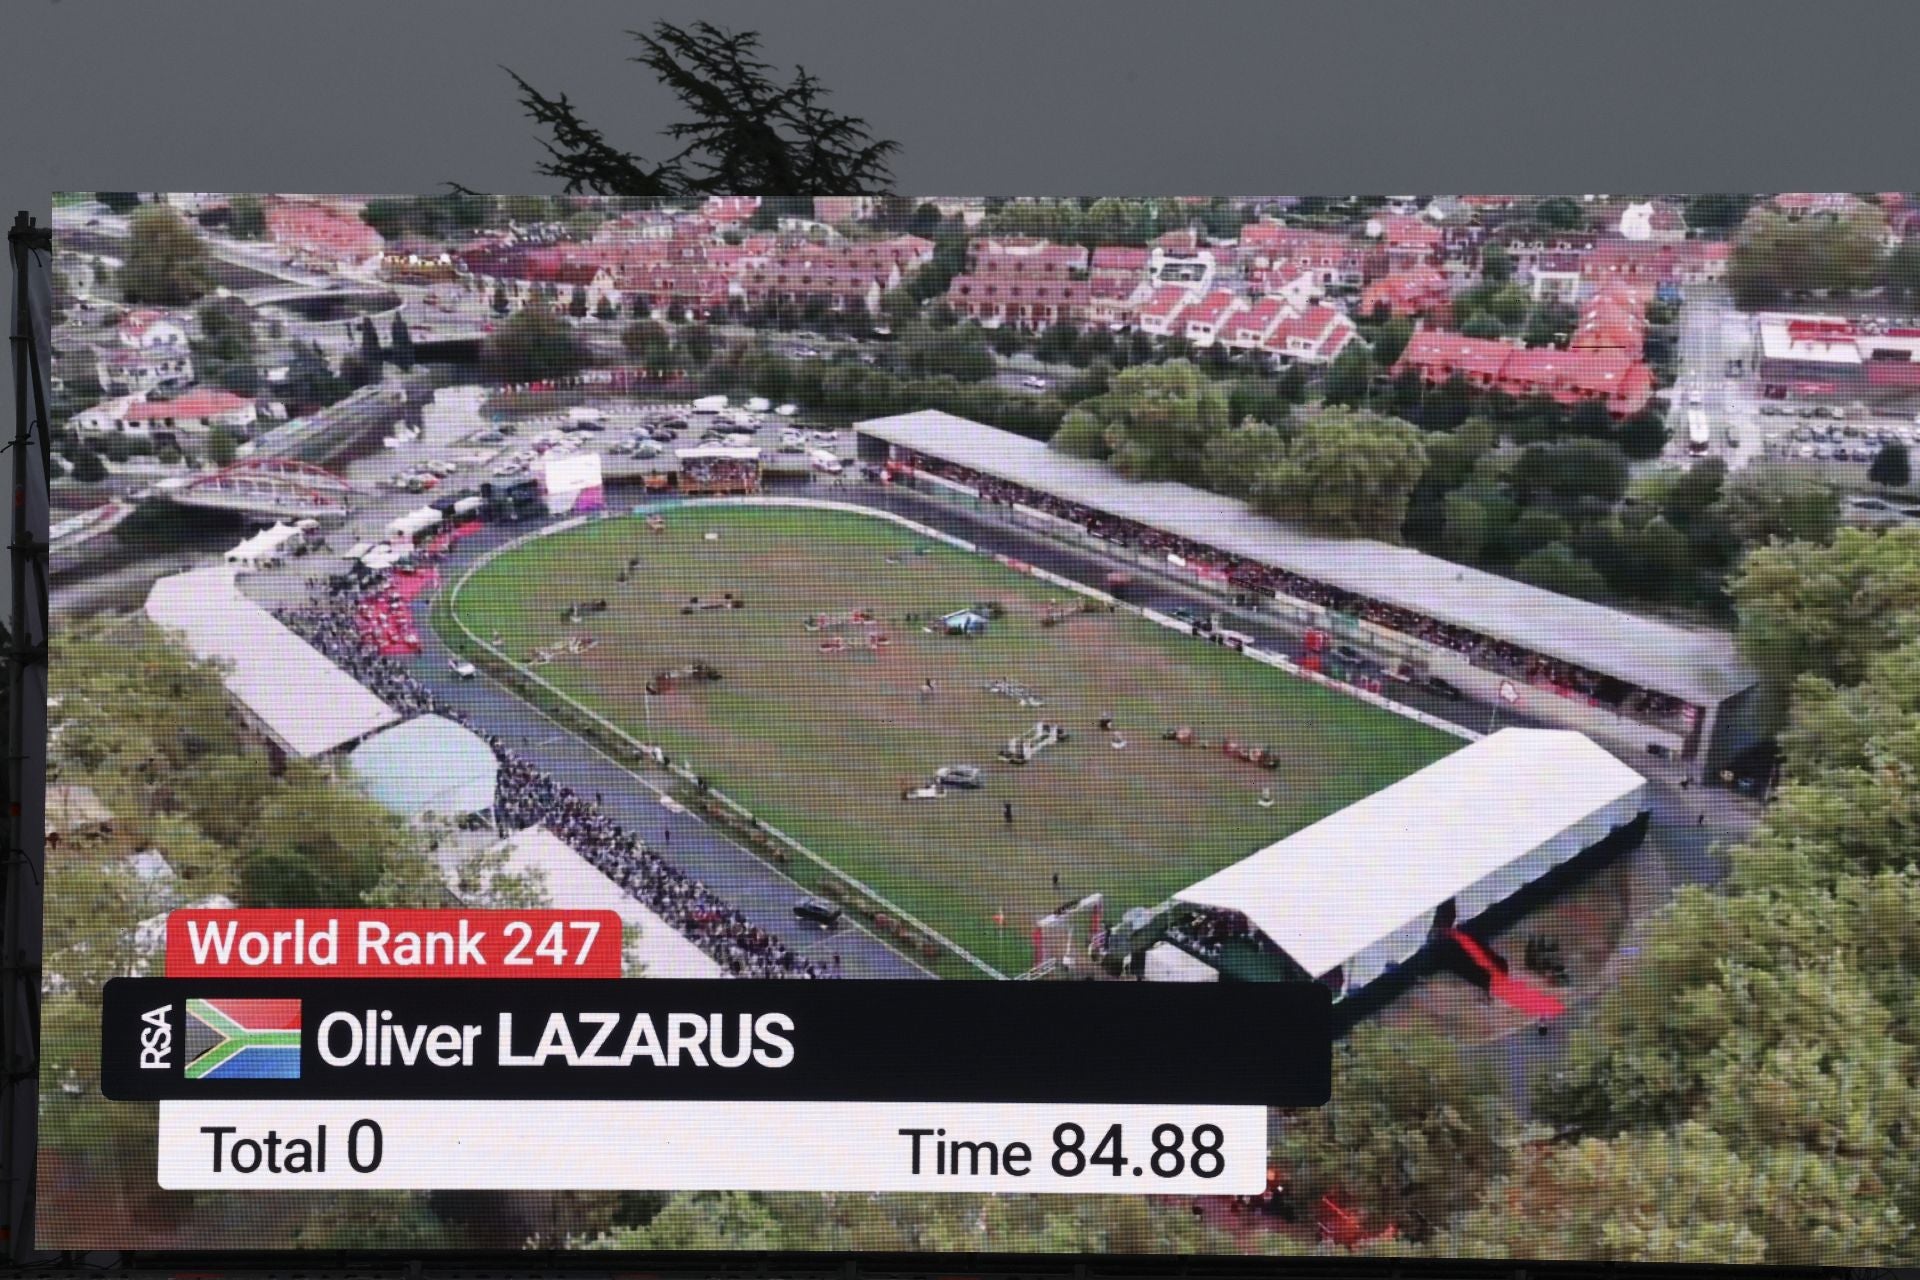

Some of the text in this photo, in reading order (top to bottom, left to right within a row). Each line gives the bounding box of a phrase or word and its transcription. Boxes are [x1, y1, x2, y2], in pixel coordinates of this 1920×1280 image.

[187, 918, 601, 966] World Rank 247
[139, 1004, 173, 1069] RSA
[317, 1009, 795, 1069] Oliver LAZARUS
[200, 1118, 383, 1174] Total 0
[898, 1122, 1225, 1179] Time 84.88
